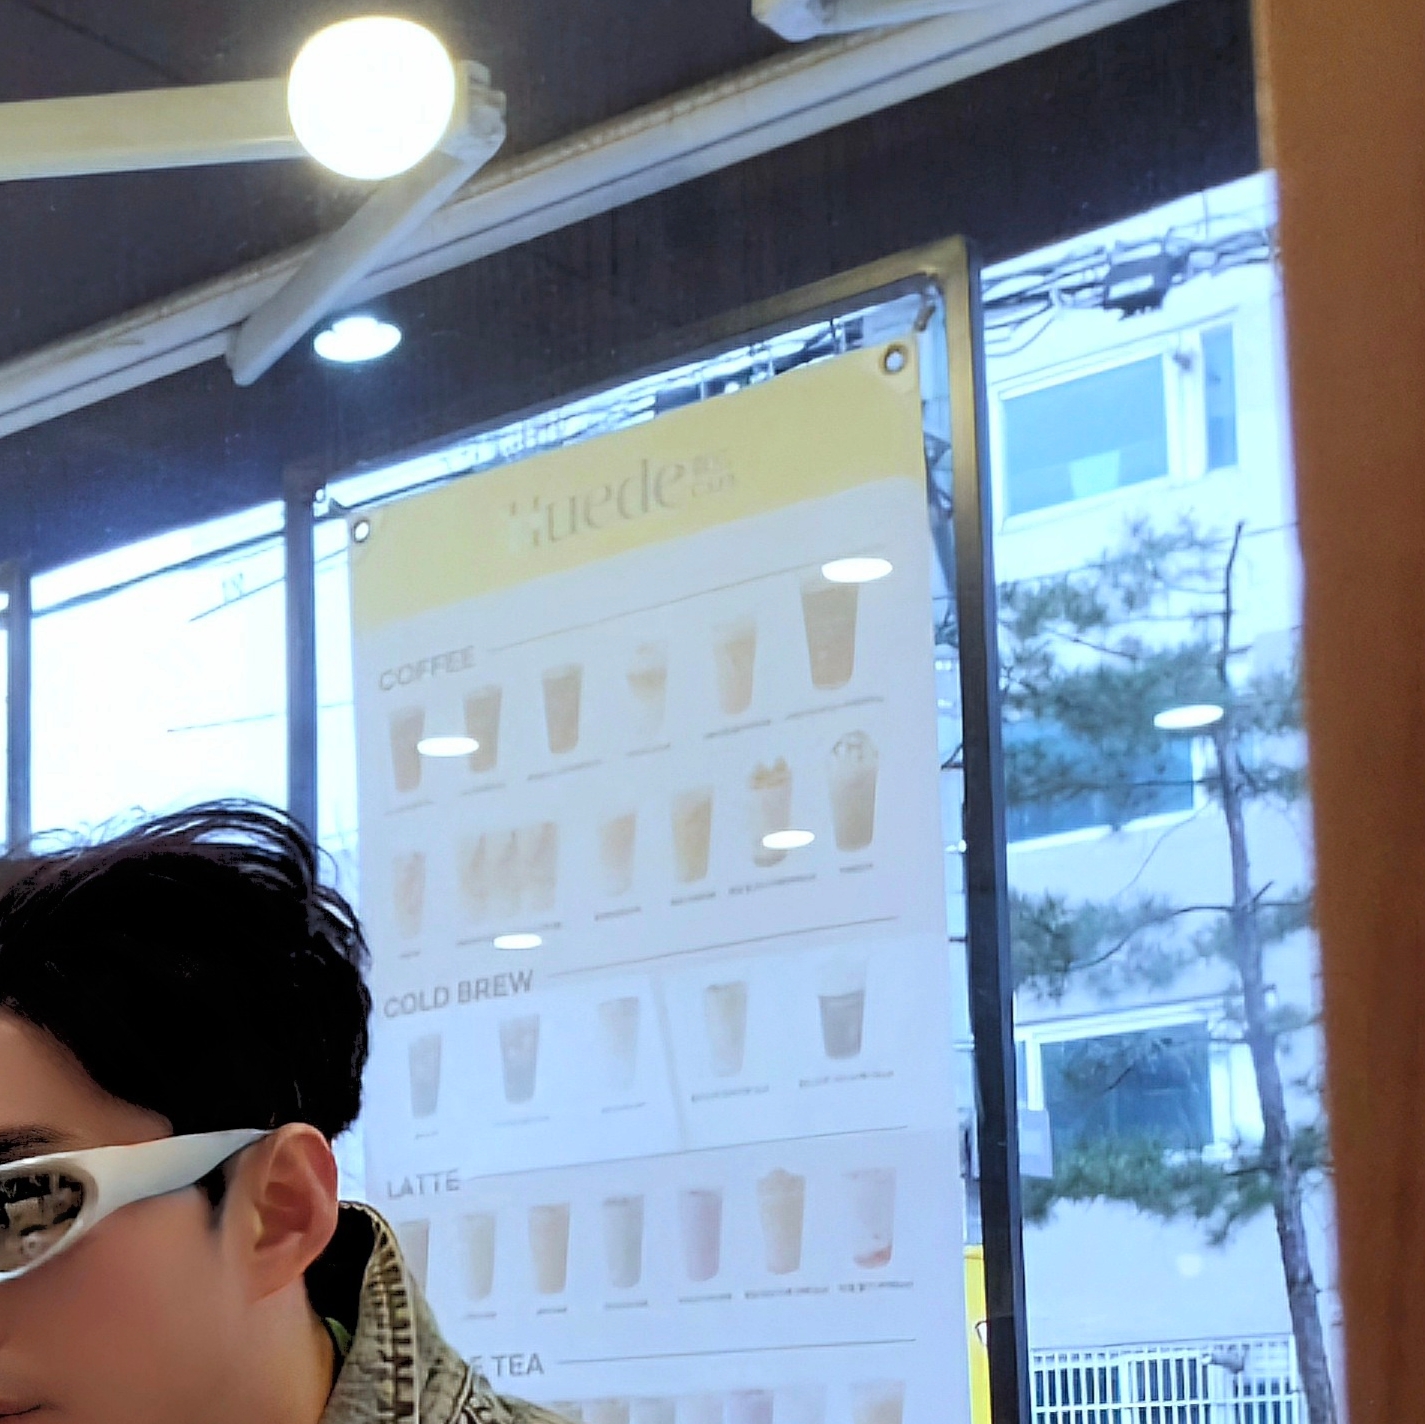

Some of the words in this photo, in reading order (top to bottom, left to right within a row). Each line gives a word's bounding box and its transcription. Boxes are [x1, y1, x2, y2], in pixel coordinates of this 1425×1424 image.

[379, 644, 474, 691] COFFEE
[383, 986, 449, 1018] COLD
[457, 969, 533, 1004] BREW
[387, 1167, 460, 1198] LATTE
[491, 1352, 544, 1377] TEA
